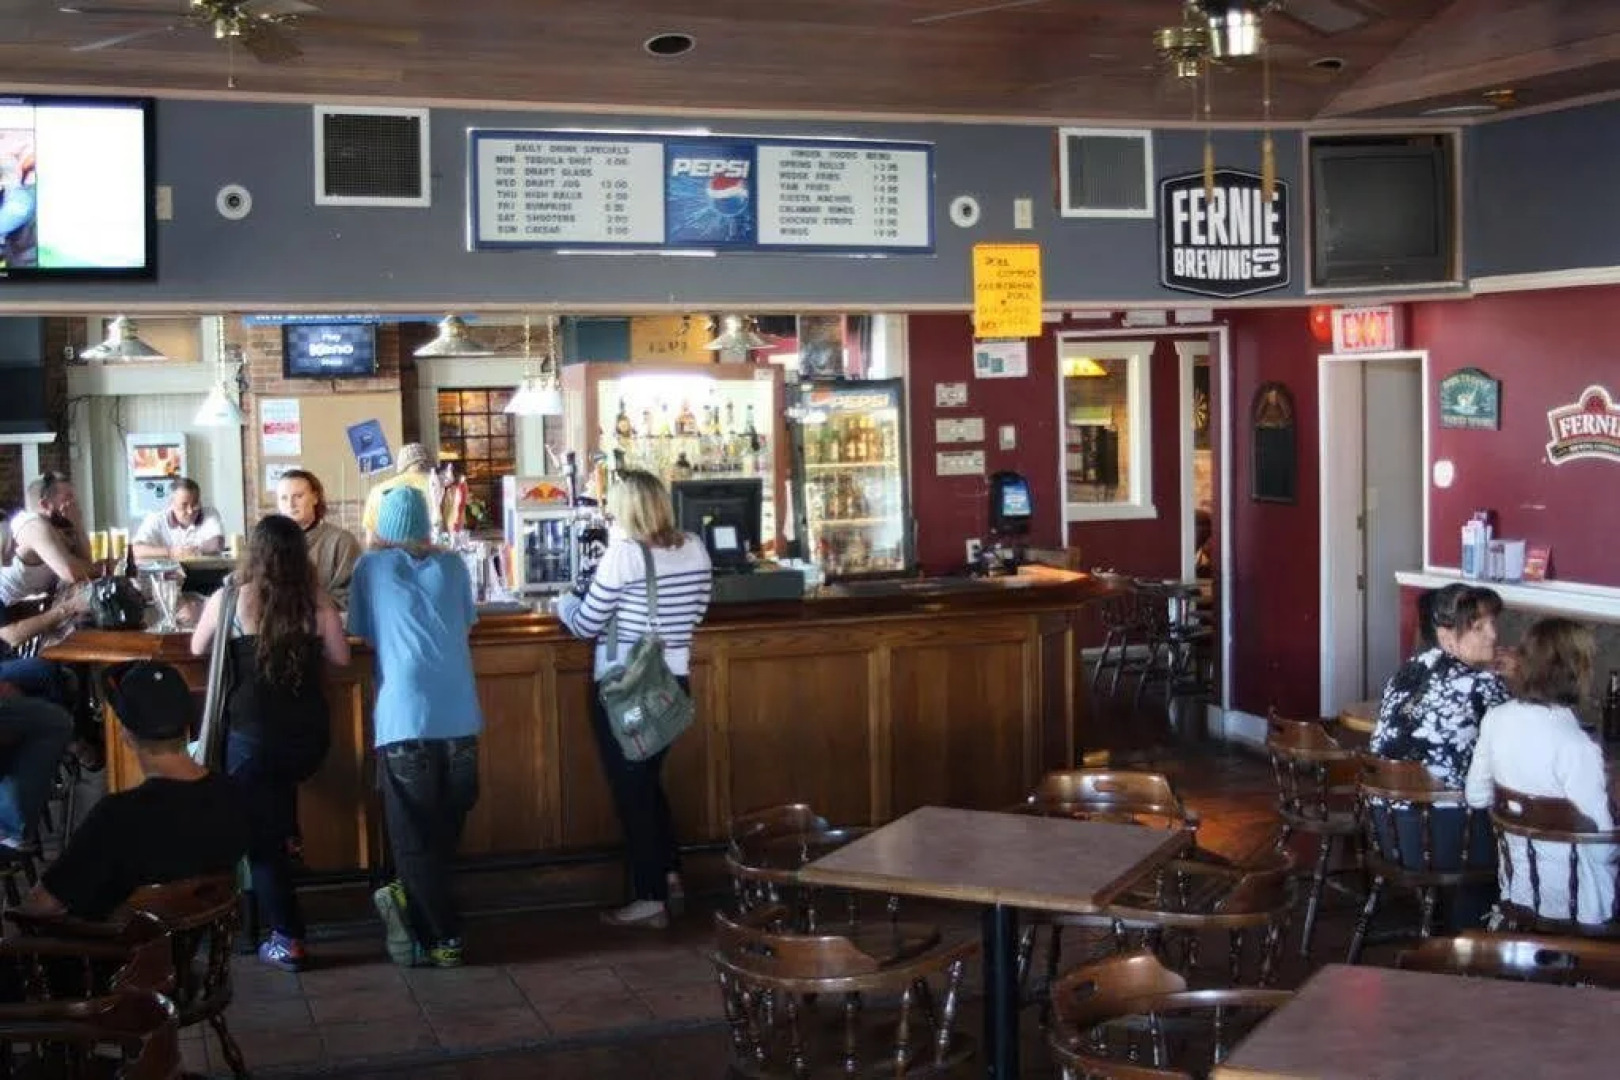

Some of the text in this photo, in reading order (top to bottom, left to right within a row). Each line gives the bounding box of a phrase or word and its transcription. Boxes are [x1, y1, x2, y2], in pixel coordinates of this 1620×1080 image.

[495, 155, 516, 164] MON
[672, 157, 750, 178] PEPSI
[496, 167, 516, 176] TUE
[495, 179, 517, 188] WED
[496, 190, 517, 200] THU
[1172, 186, 1280, 246] FERNIE
[1173, 248, 1251, 280] BREWING
[1342, 312, 1388, 348] EXIT
[1559, 413, 1620, 439] FERNI
